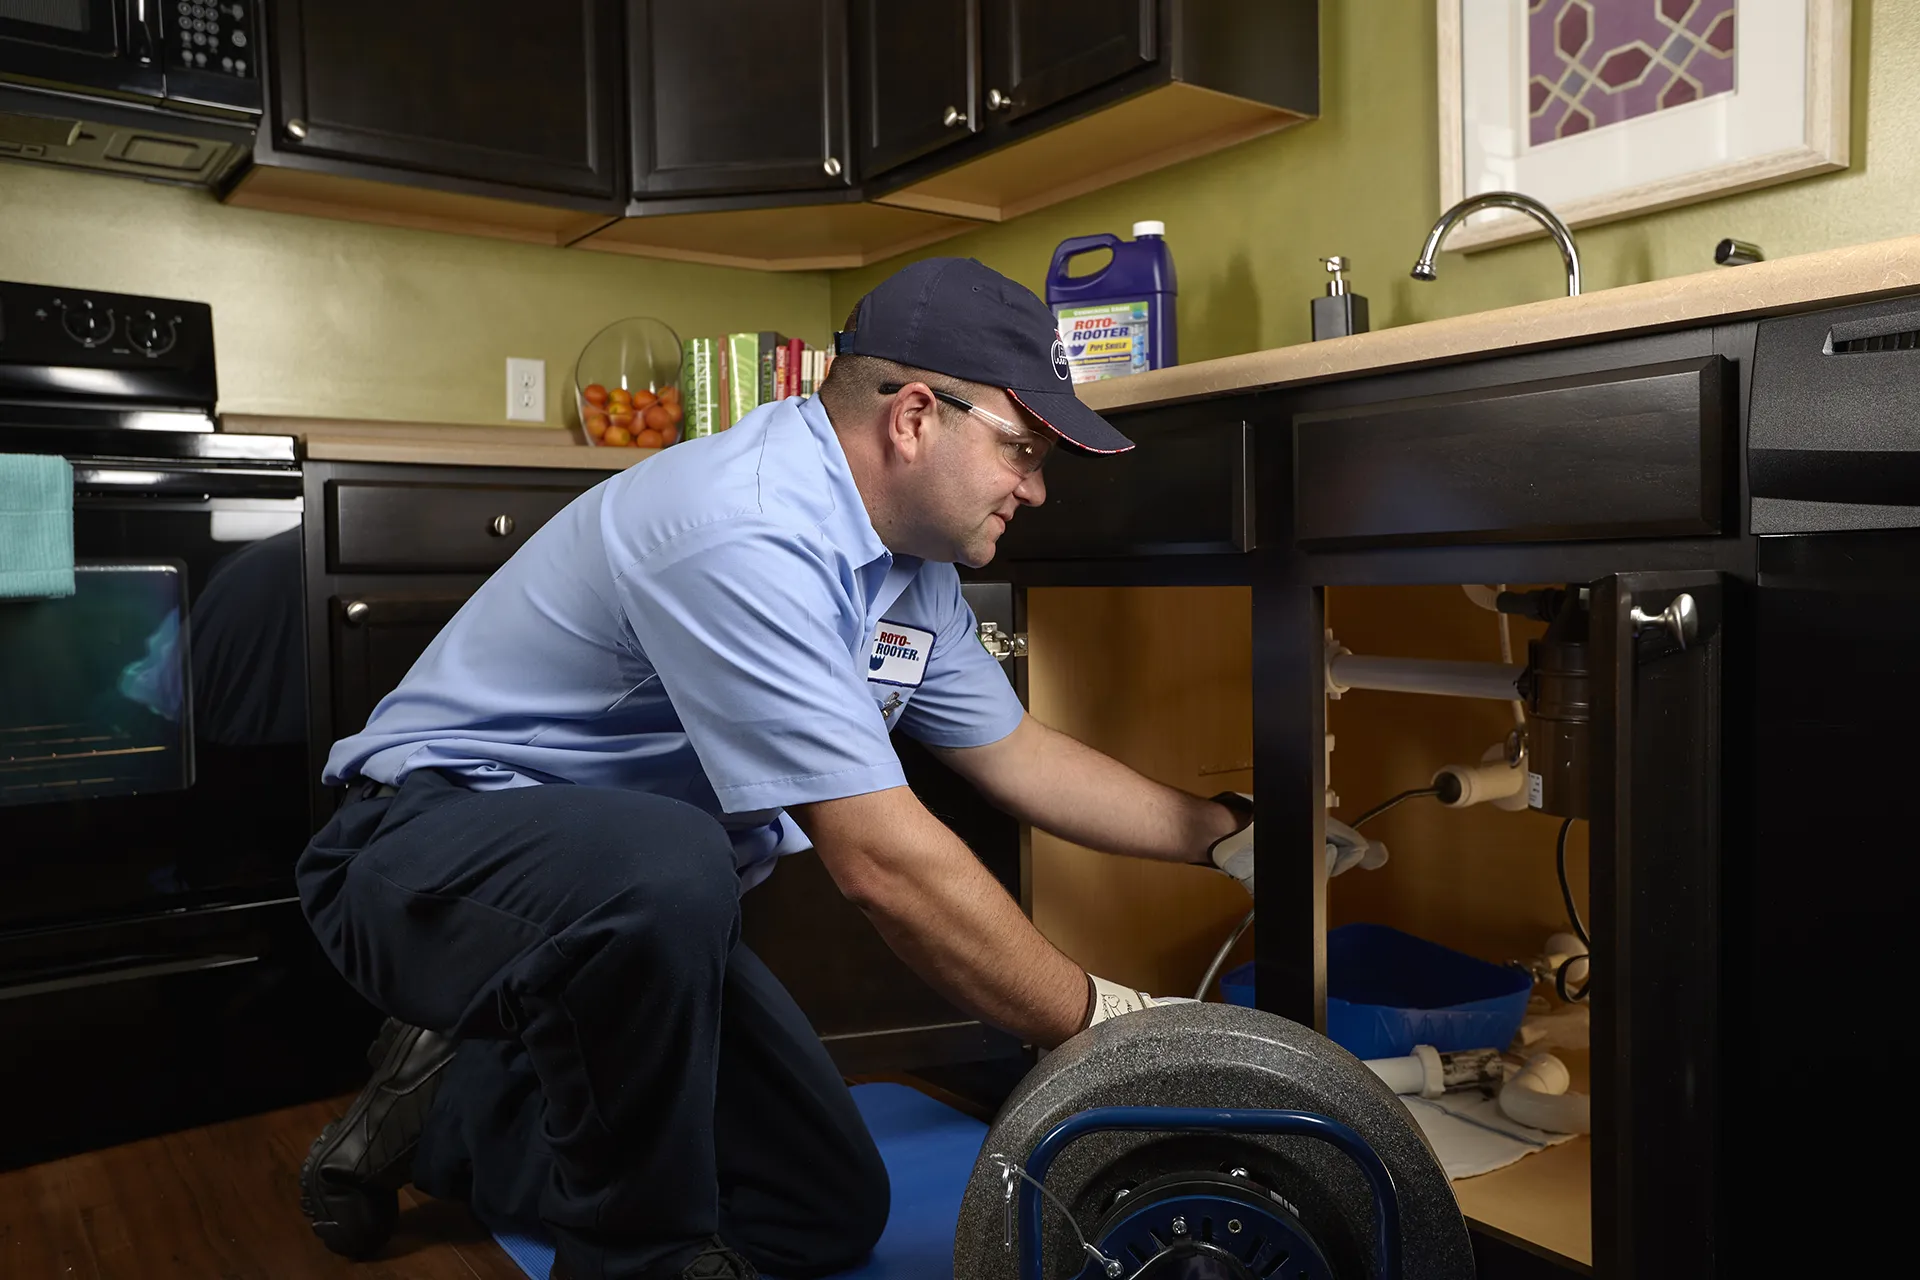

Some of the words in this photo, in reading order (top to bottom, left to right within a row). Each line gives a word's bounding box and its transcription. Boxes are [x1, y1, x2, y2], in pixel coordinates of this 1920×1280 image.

[1074, 317, 1117, 330] ROTO-
[1072, 326, 1129, 341] ROOTER
[879, 631, 911, 646] ROTO-
